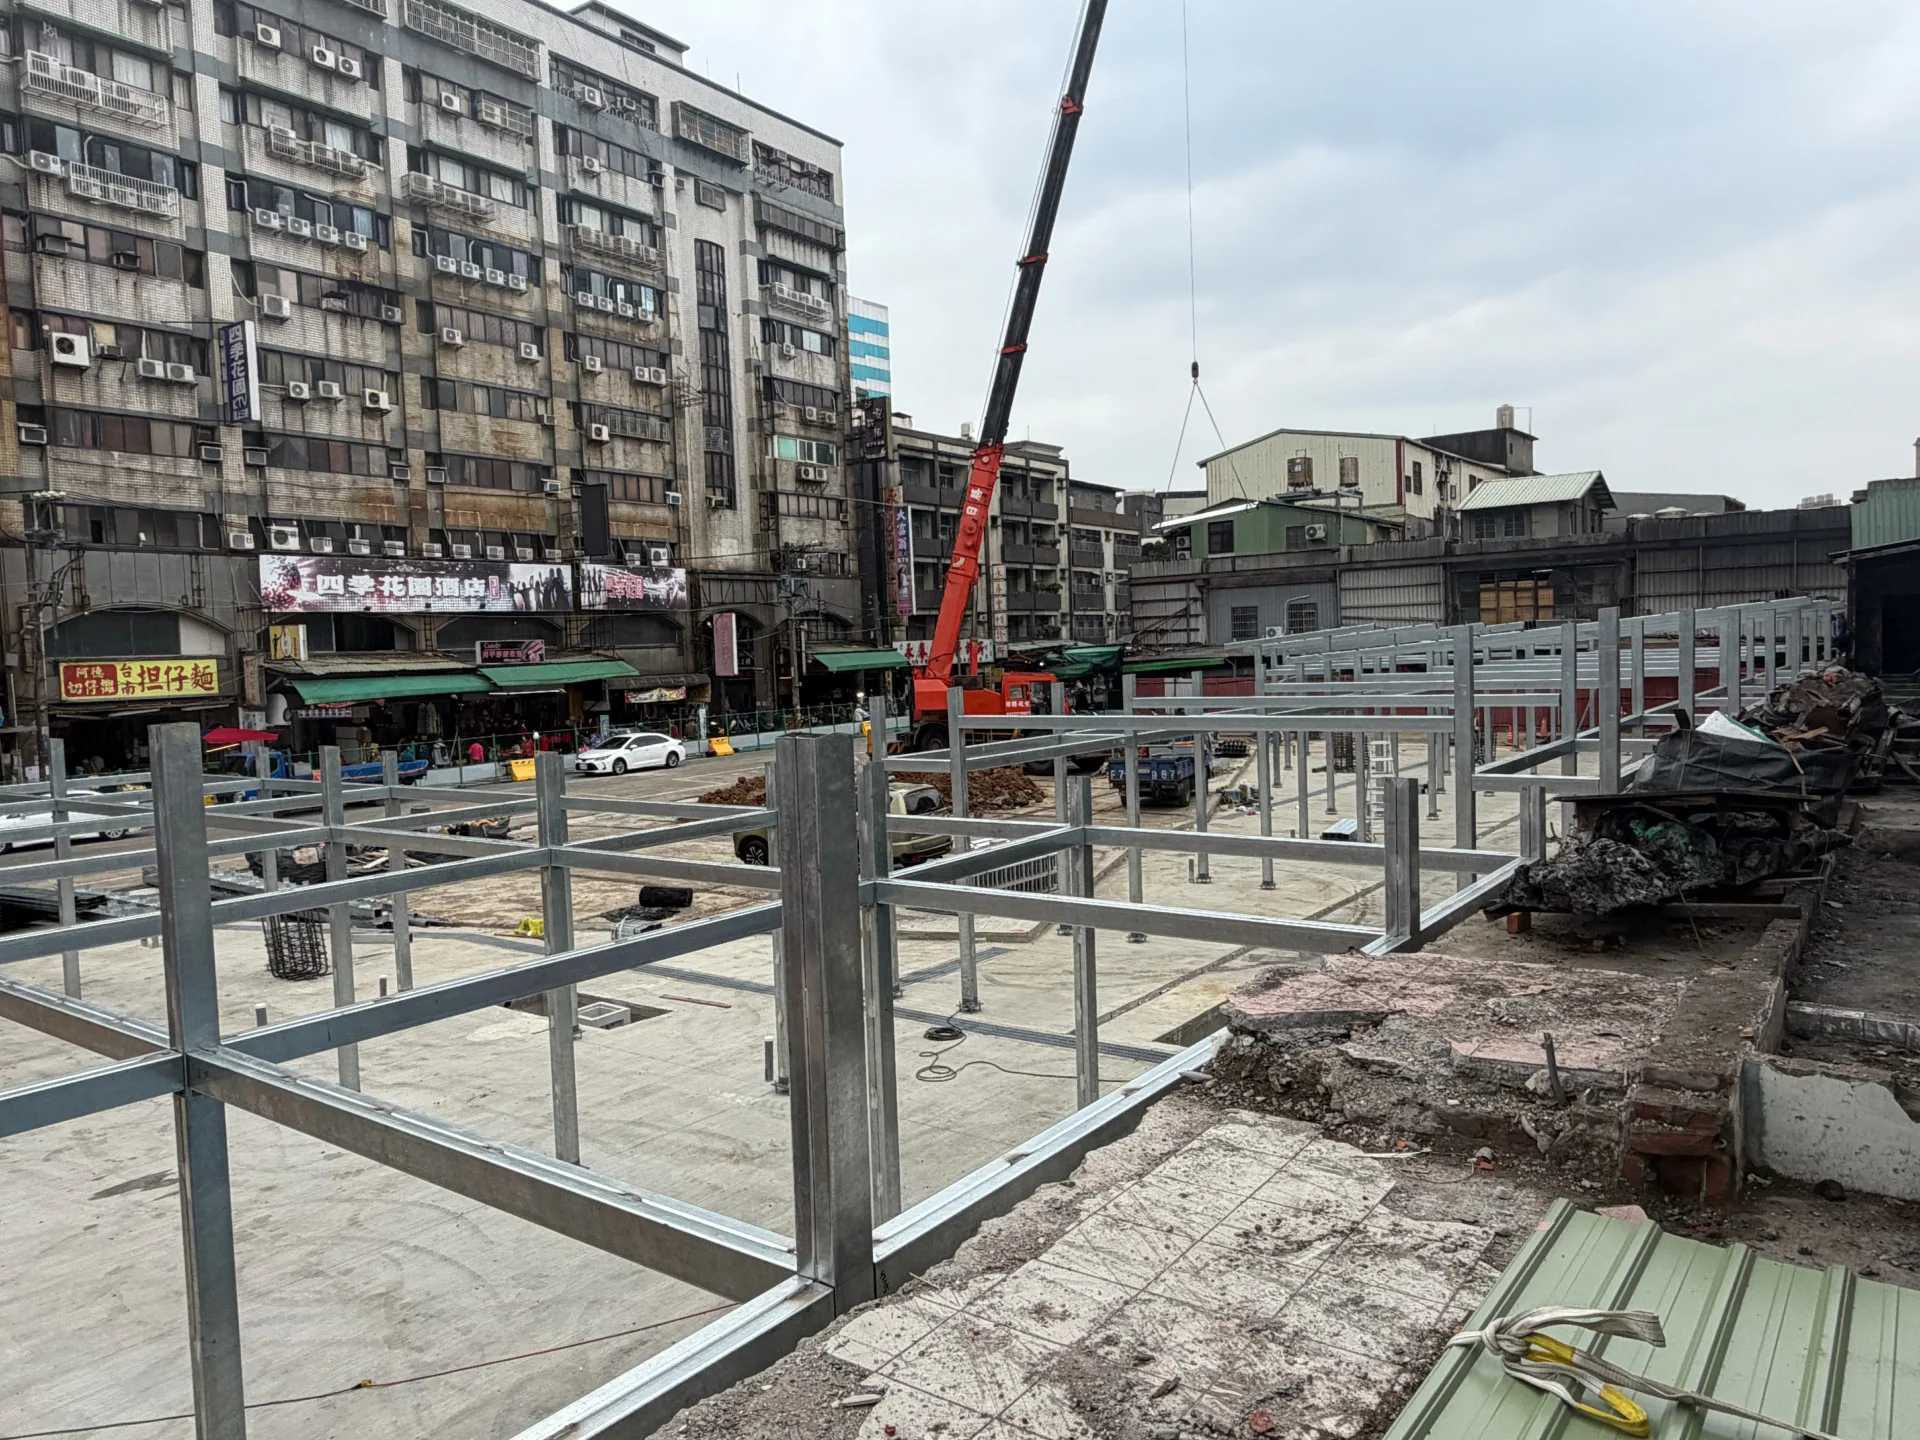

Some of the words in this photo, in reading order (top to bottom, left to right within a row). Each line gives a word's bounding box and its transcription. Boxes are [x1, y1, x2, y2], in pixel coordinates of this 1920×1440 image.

[229, 325, 247, 396] 四季花園
[316, 574, 486, 598] 四季花園酒店
[137, 663, 215, 693] 担仔麵
